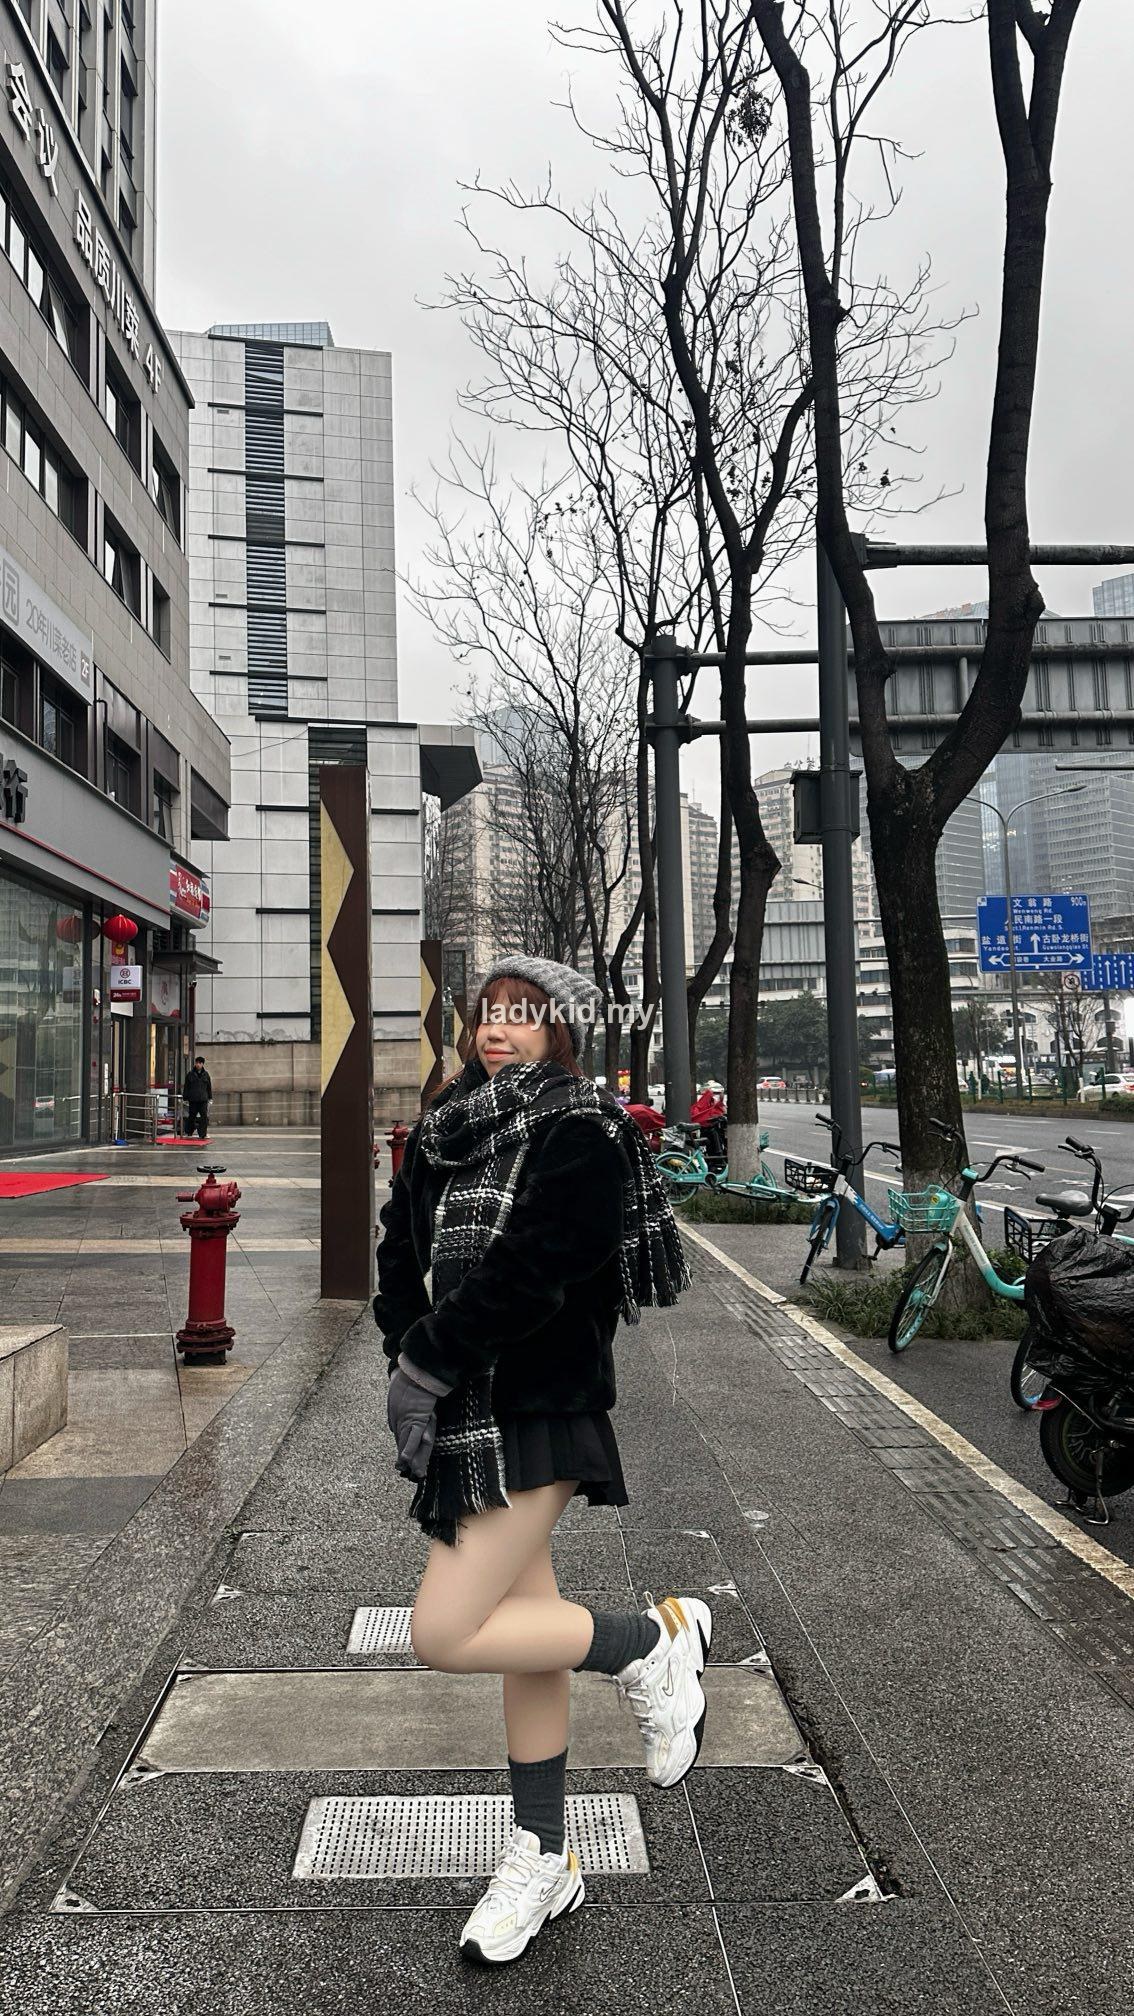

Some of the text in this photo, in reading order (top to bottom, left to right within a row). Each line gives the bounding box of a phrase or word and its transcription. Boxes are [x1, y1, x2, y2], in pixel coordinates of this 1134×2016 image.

[74, 187, 140, 360] 品质川菜
[143, 343, 162, 394] 4F
[25, 598, 77, 673] 20年川菜老店
[81, 658, 90, 680] 2F
[1012, 897, 1053, 908] 文翁路
[981, 935, 1022, 946] 盐道街
[1042, 933, 1089, 944] 古卧龙桥街
